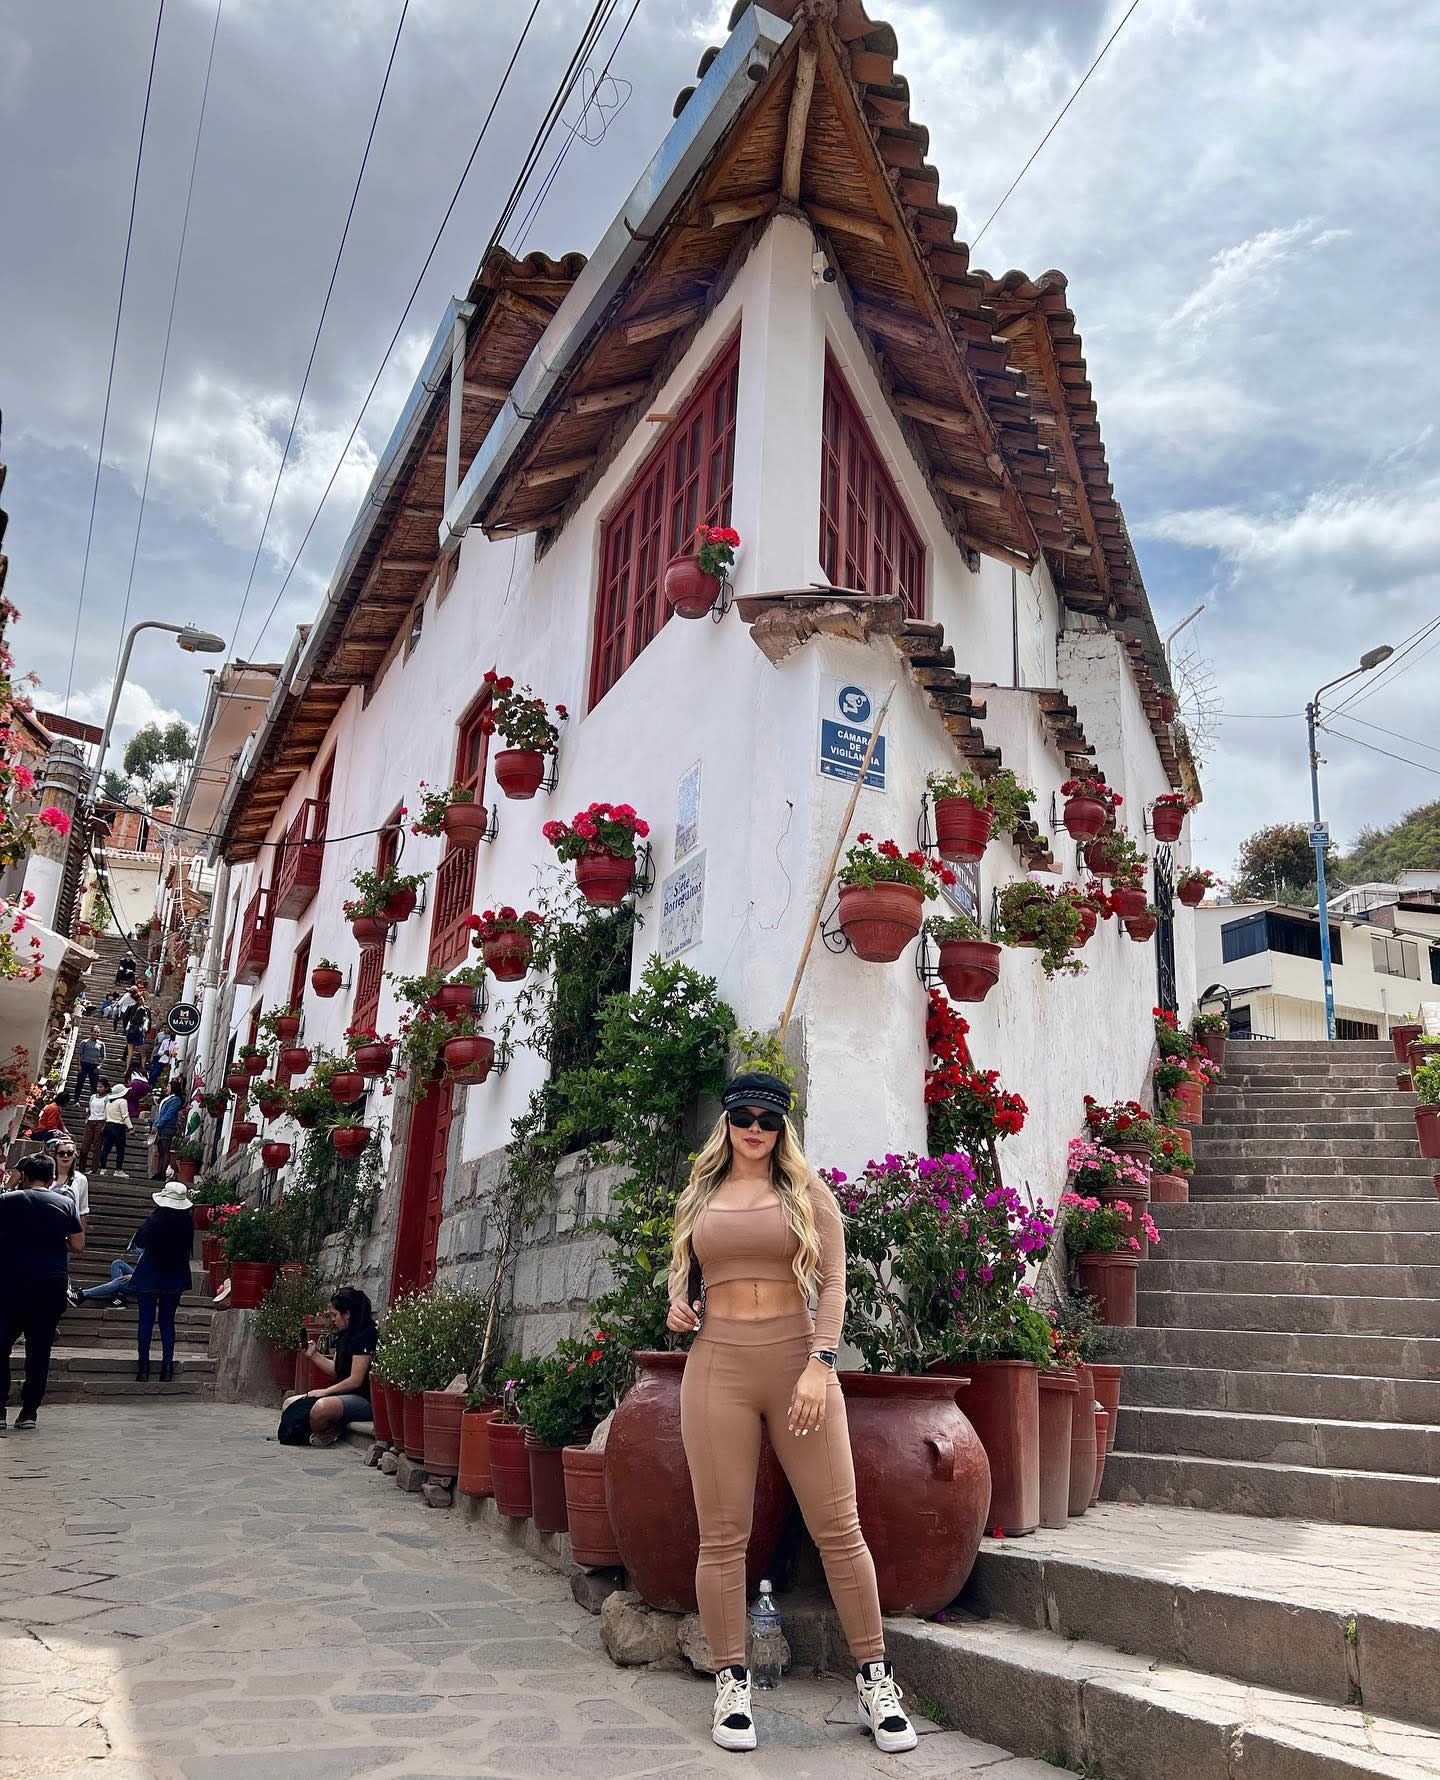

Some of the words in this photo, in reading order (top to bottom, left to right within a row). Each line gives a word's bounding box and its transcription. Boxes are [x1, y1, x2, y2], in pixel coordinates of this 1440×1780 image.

[830, 745, 880, 766] VIGILANIA
[849, 742, 861, 752] DE
[673, 878, 690, 898] Siete
[663, 882, 702, 917] Borreguitos
